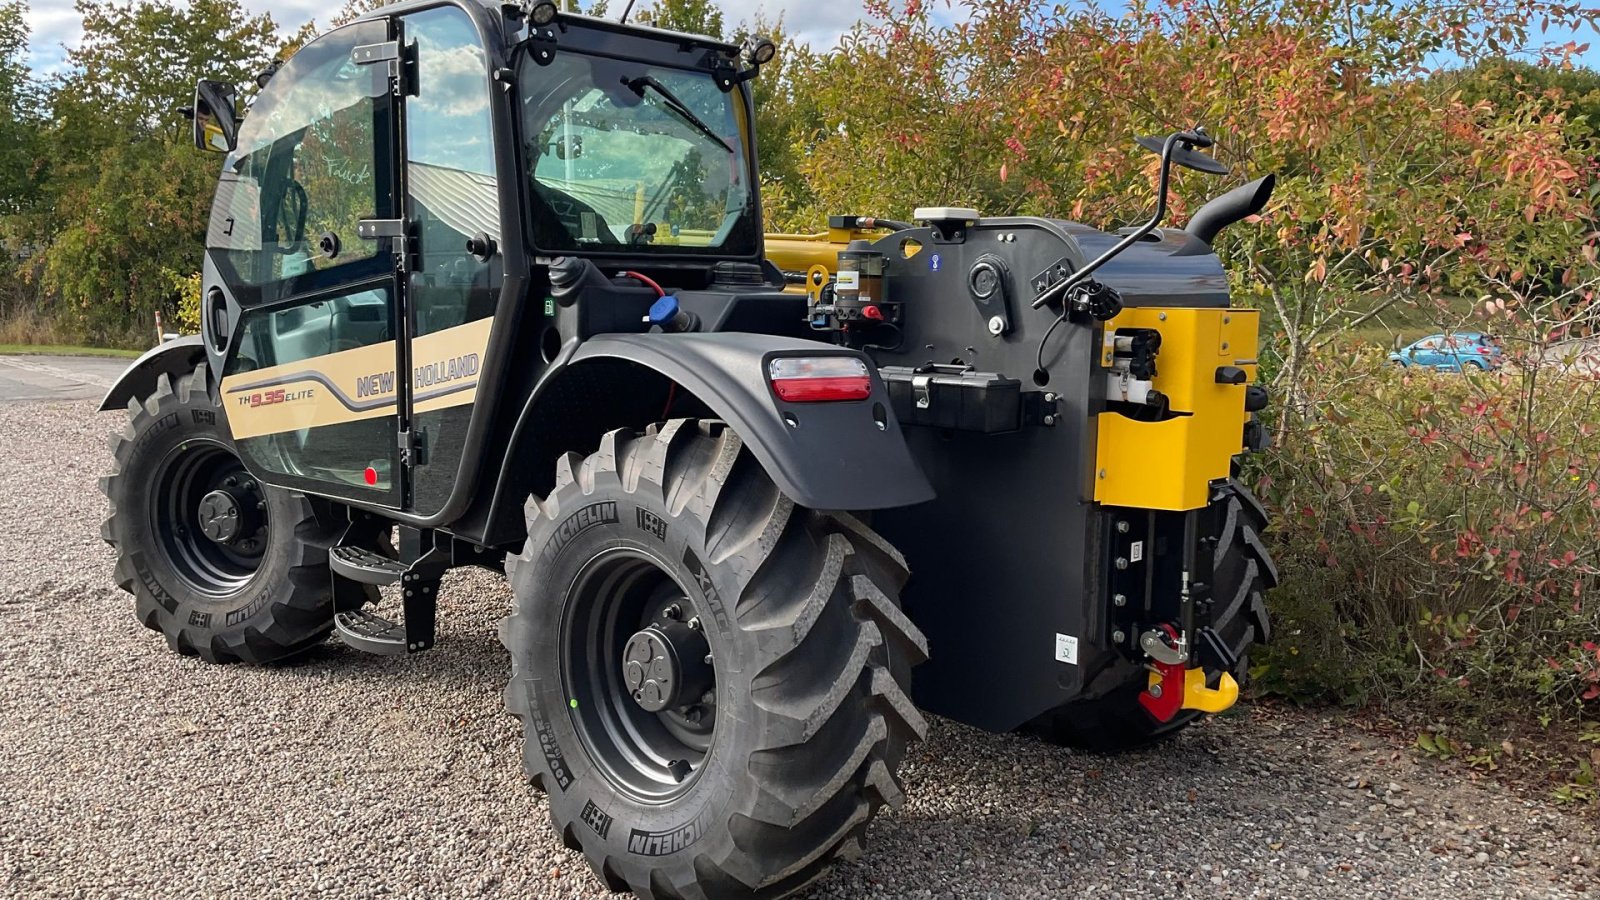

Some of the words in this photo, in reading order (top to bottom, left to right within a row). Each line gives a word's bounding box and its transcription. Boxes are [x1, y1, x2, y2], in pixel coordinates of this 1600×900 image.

[357, 371, 394, 397] NEW
[414, 353, 478, 389] HOLLAND
[544, 502, 616, 560] MICHELIN
[630, 803, 714, 855] MICHELIN
